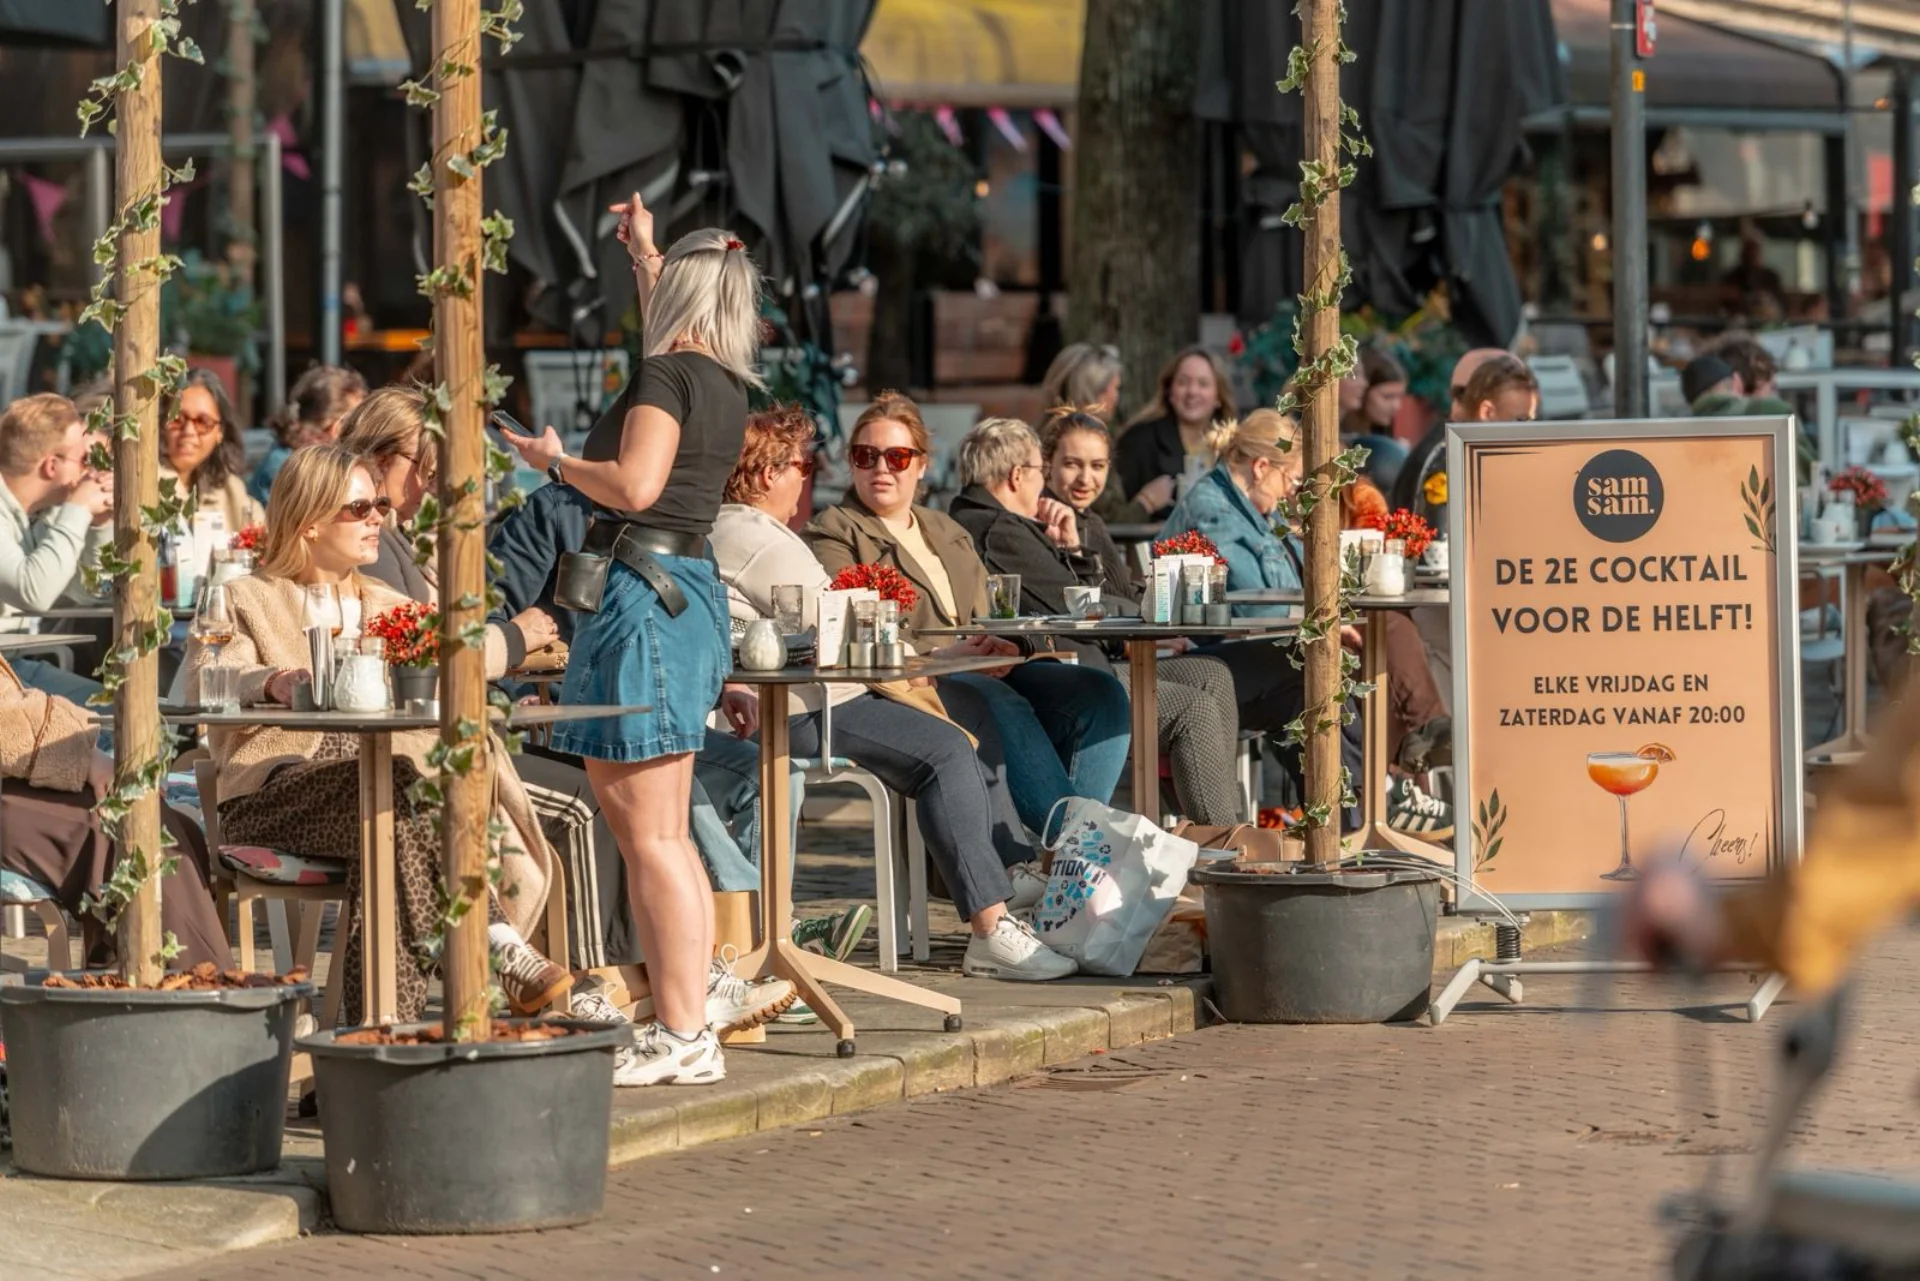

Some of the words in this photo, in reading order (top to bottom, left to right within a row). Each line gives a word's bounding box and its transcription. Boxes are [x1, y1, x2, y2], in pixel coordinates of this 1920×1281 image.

[1587, 476, 1649, 496] sam
[1587, 496, 1655, 516] sam.
[1495, 559, 1534, 586] DE
[1544, 557, 1578, 584] 2E
[1589, 554, 1748, 583] COCKTAIL
[1491, 606, 1591, 635] VOOR
[1602, 605, 1641, 632] DE
[1653, 603, 1753, 632] HELFT!
[1533, 675, 1580, 695] ELKE
[1586, 674, 1676, 694] VRIJDAG
[1683, 674, 1709, 693] EN
[1499, 707, 1606, 727] ZATERDAG
[1612, 706, 1682, 725] VANAF
[1689, 705, 1746, 724] 20:00
[1050, 859, 1091, 877] TION
